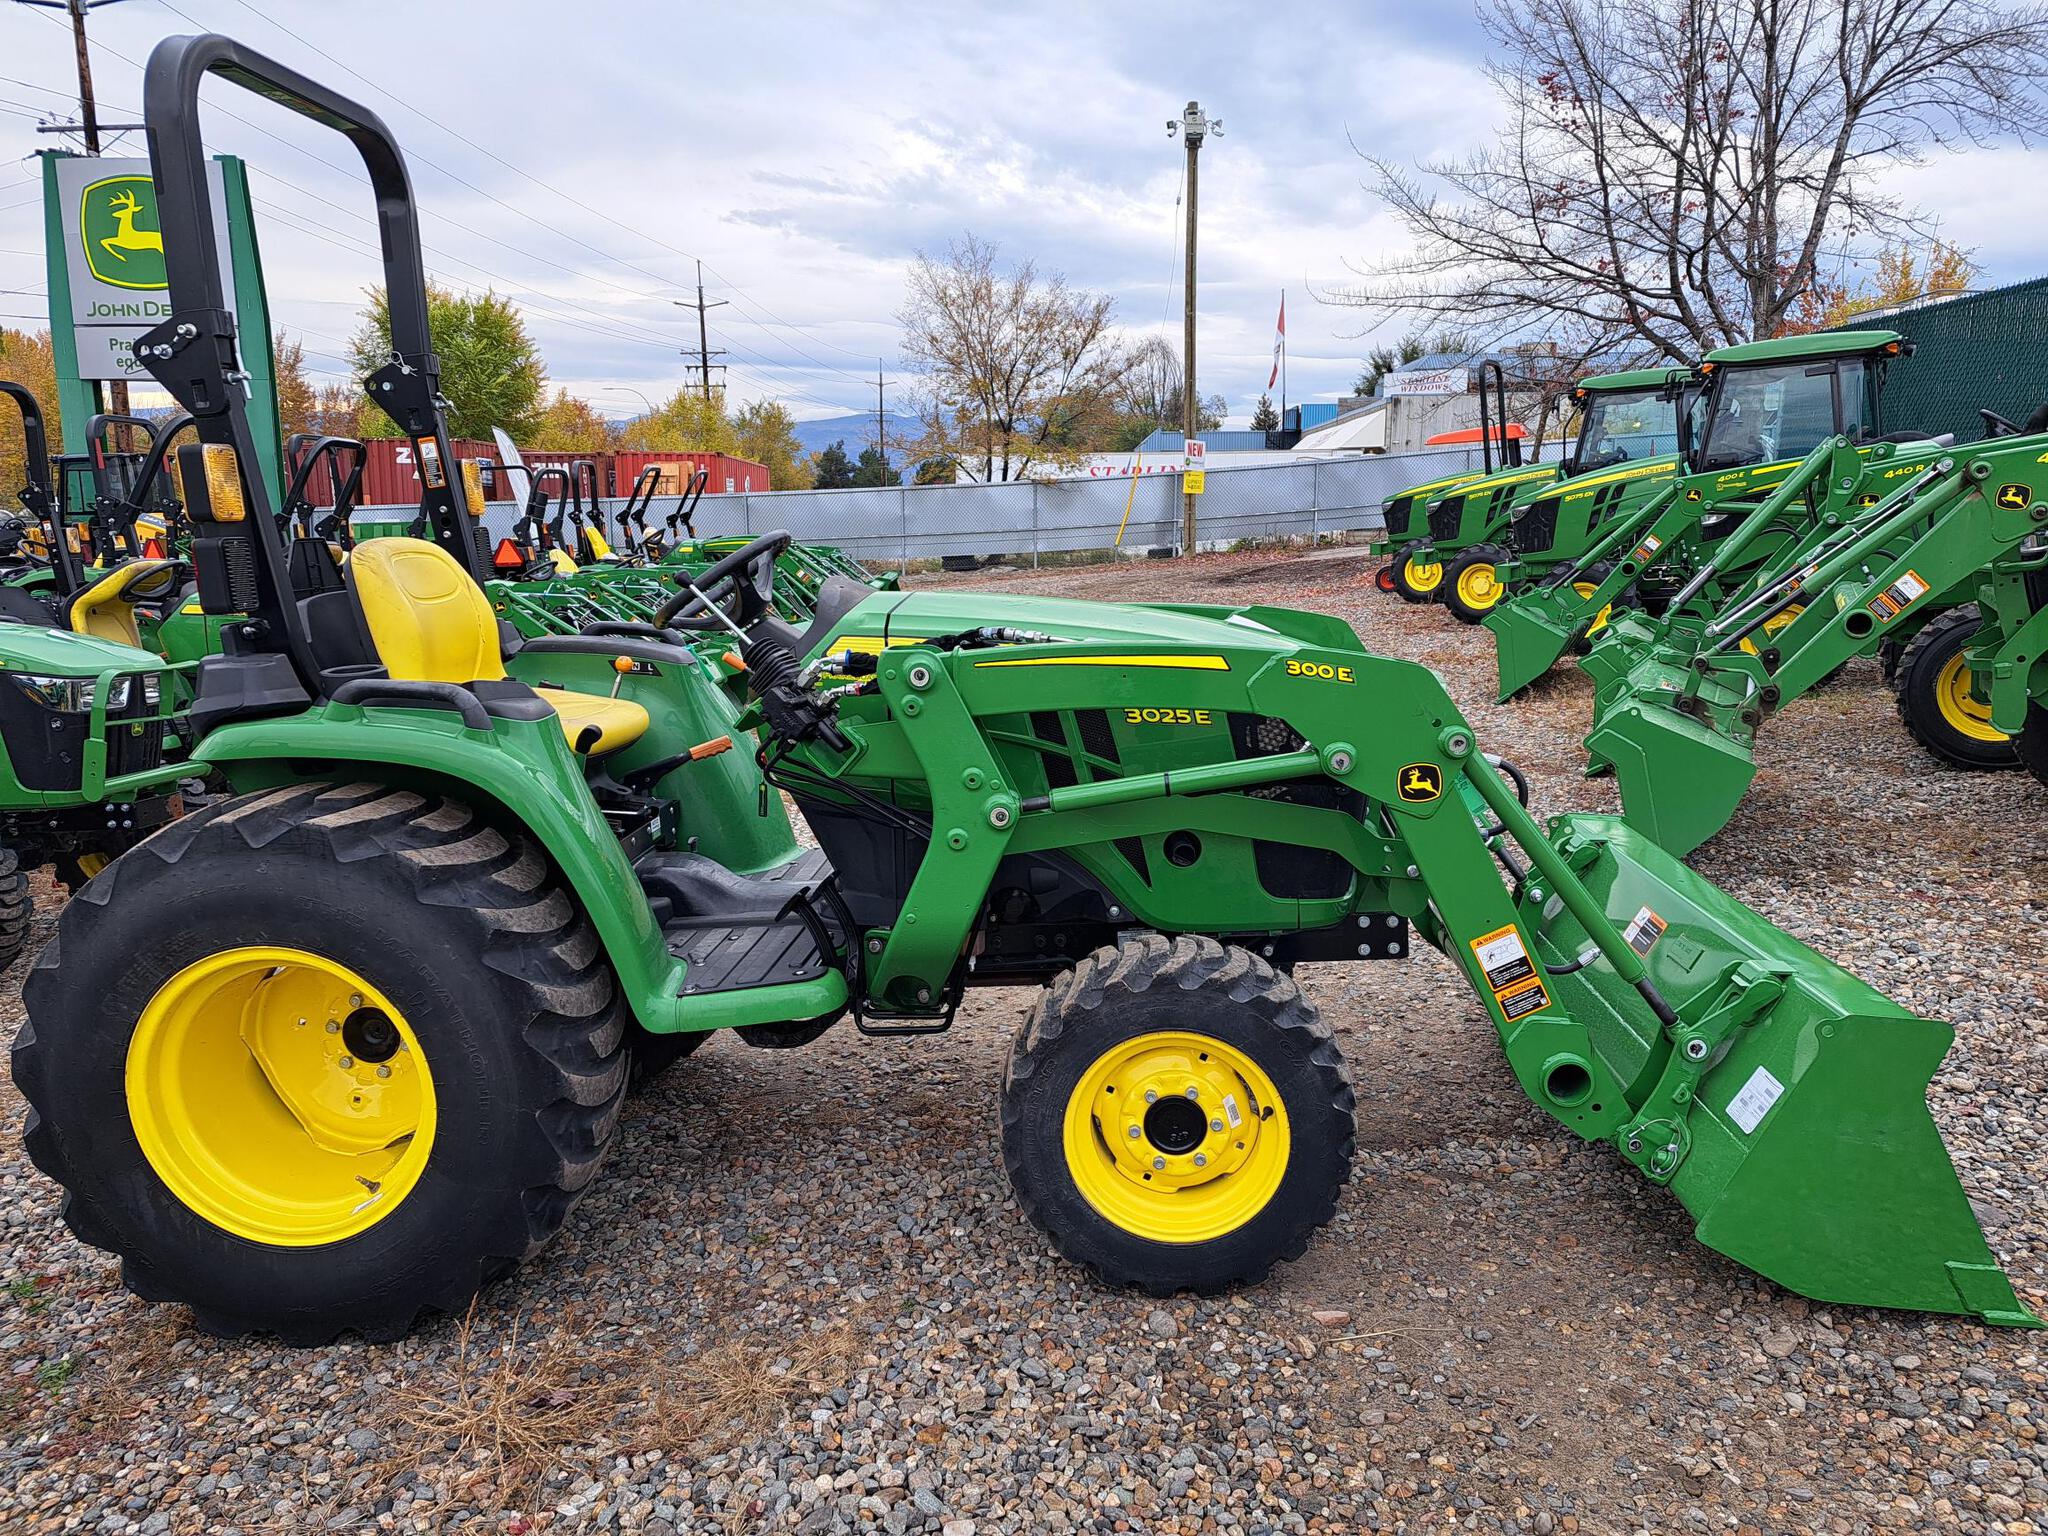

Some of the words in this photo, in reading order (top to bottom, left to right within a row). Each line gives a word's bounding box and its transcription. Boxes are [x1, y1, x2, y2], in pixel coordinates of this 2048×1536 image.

[87, 301, 140, 317] JOHN
[1400, 383, 1449, 393] WINDOWS
[1187, 441, 1204, 458] NEW
[1625, 470, 1644, 478] JOHN
[1645, 465, 1670, 476] DEERE
[1883, 466, 1914, 479] 440
[1483, 928, 1511, 944] WARNING
[1507, 981, 1537, 994] WARNING
